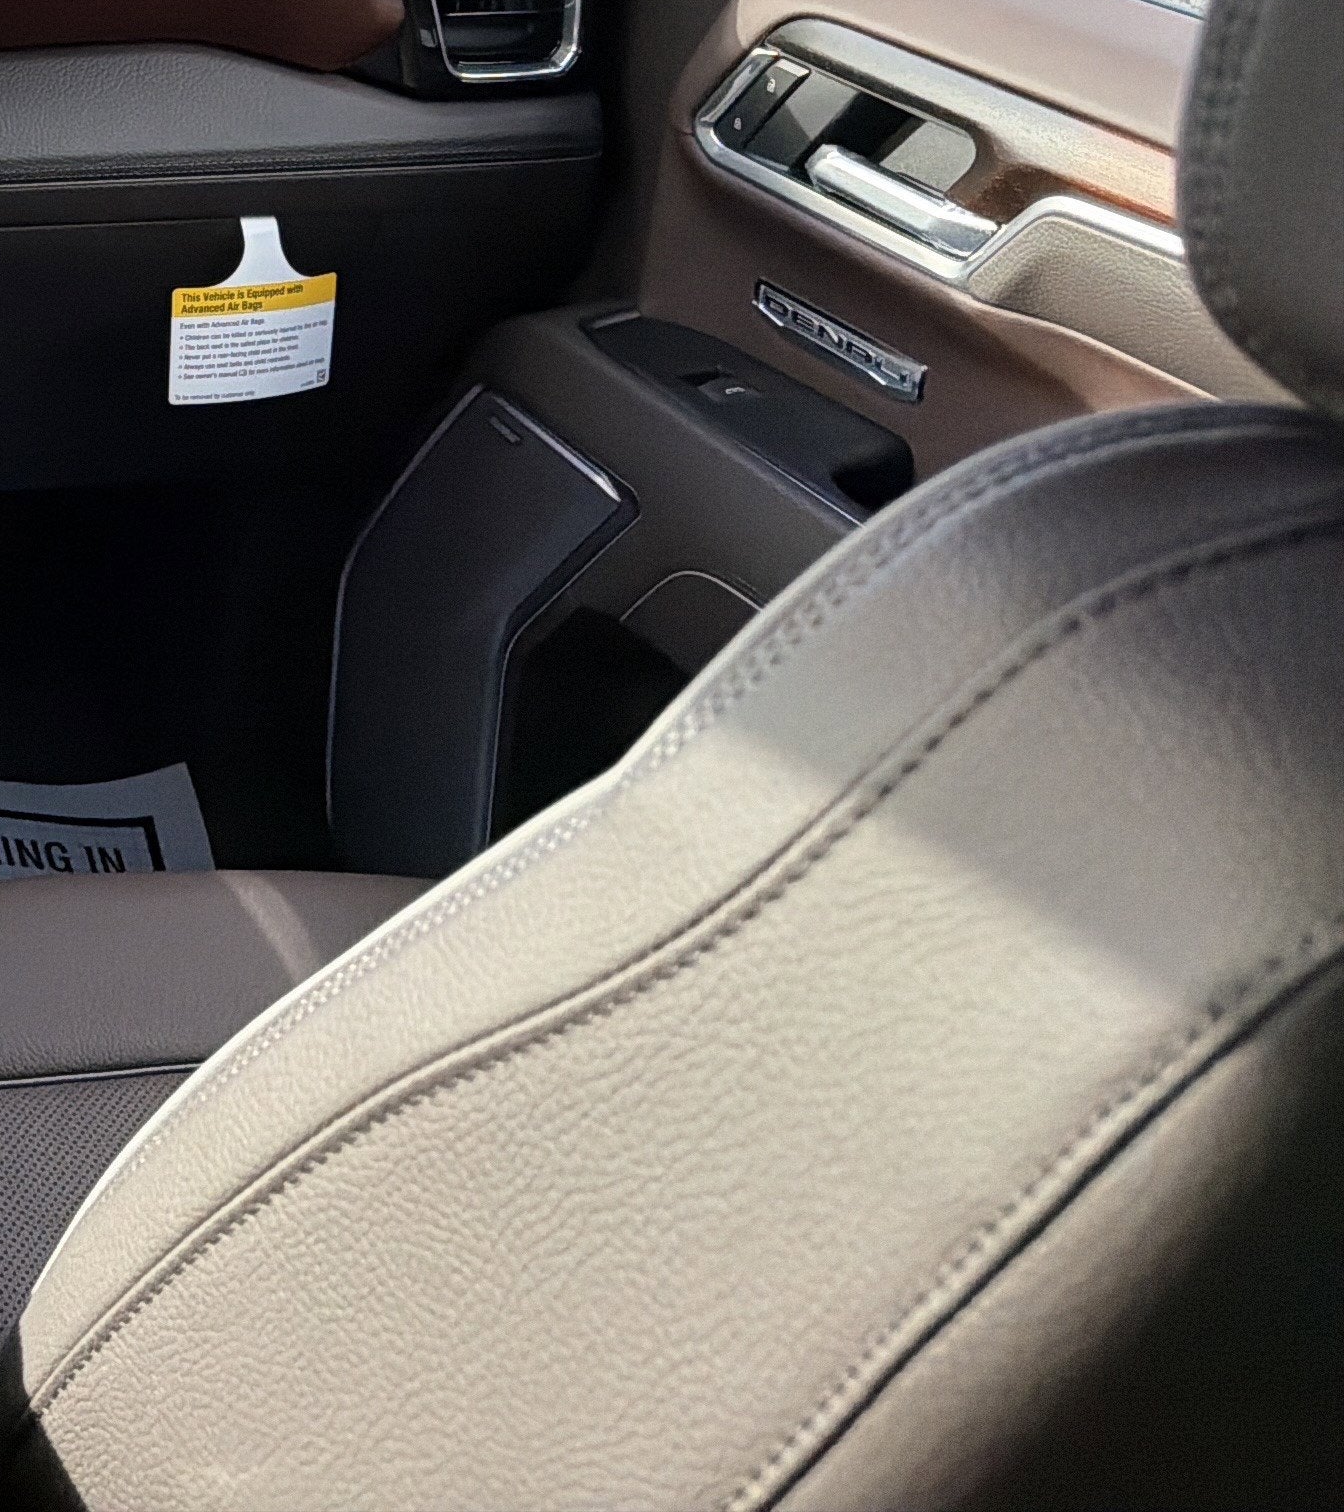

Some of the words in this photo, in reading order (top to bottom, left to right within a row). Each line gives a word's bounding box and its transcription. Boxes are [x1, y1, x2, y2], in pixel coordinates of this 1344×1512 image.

[181, 292, 201, 303] This
[203, 291, 235, 302] Vehicle
[237, 290, 244, 299] is
[246, 286, 286, 300] Equipped
[287, 284, 304, 295] with
[181, 302, 225, 314] Advanced
[227, 302, 240, 311] Air
[242, 300, 263, 312] Bags
[180, 322, 196, 330] Even
[211, 320, 240, 328] Advanced
[764, 294, 909, 384] DENALI
[86, 845, 127, 874] IN
